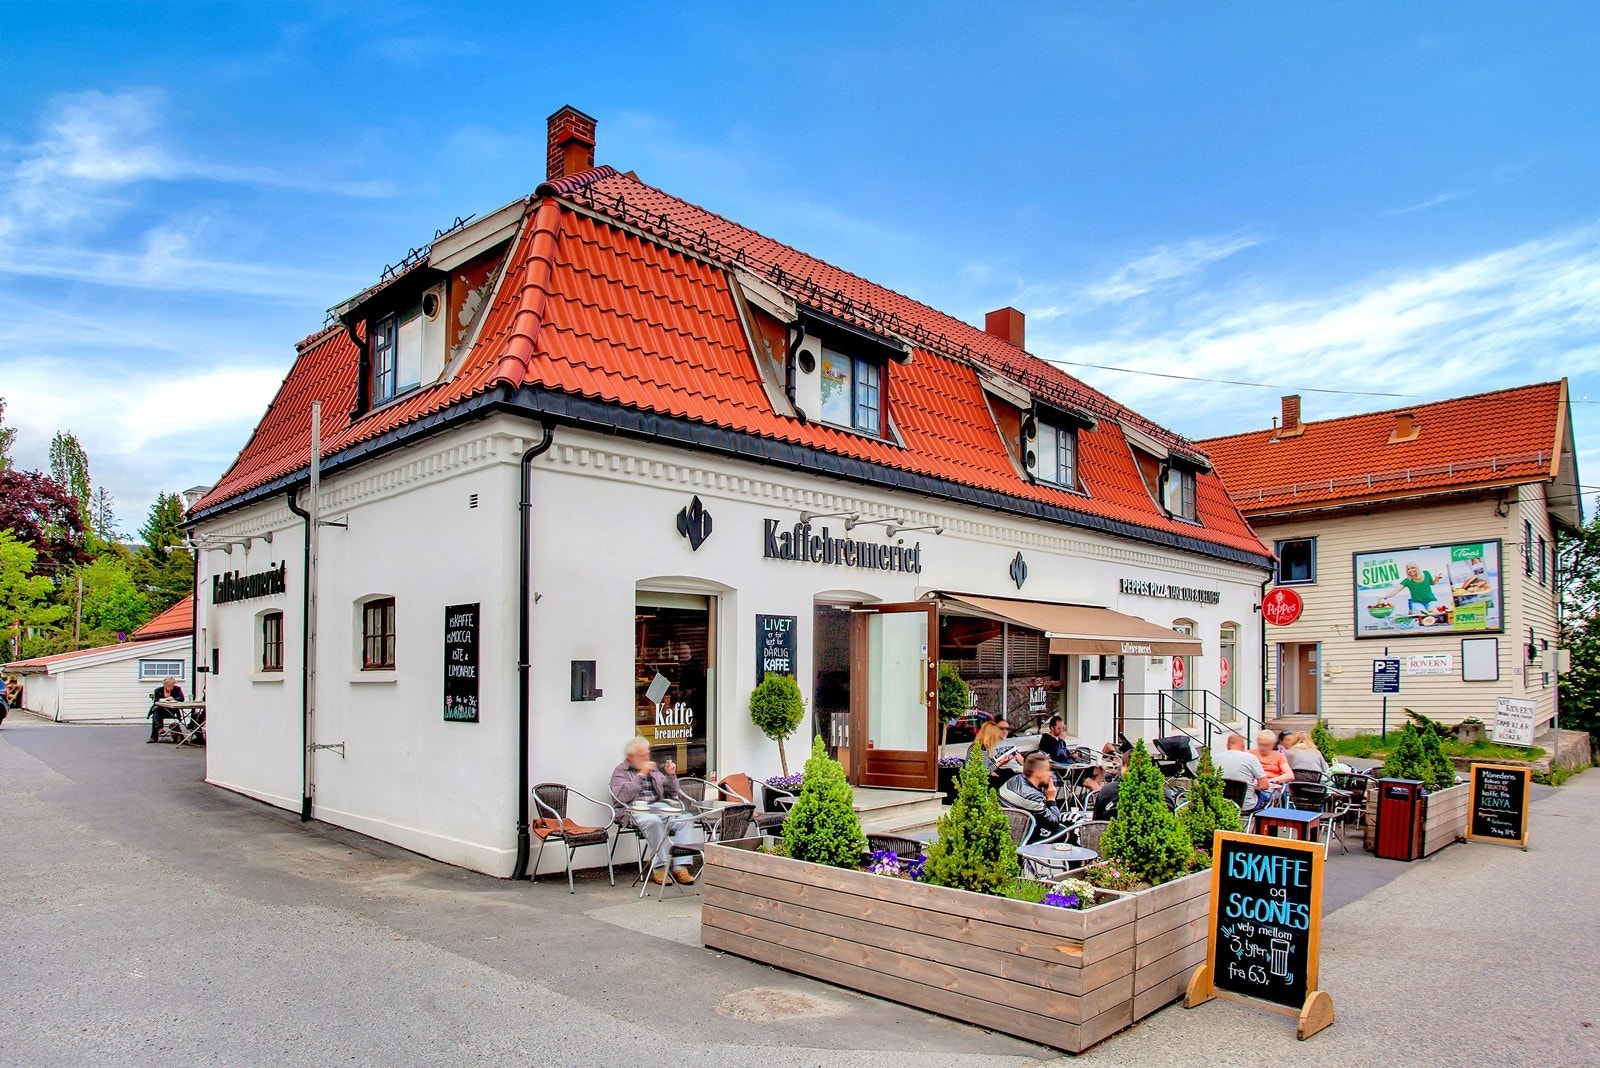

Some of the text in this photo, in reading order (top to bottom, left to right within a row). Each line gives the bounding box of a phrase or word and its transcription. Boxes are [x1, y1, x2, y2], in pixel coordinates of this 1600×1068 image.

[763, 518, 922, 574] Kaffebrenneriet
[1362, 563, 1400, 585] SUNN
[1120, 578, 1149, 596] PEPPES
[1149, 583, 1168, 598] PIZZA
[1266, 602, 1297, 616] Peppes
[764, 618, 792, 632] LIVET
[764, 646, 788, 658] DÅRLIG
[764, 658, 790, 671] KAFFE
[1374, 661, 1386, 673] P
[968, 690, 978, 706] ffe
[1029, 686, 1047, 703] Kaffe
[655, 701, 694, 726] Kaffe
[654, 726, 693, 739] brenneriet
[1481, 797, 1510, 808] KENYA
[1228, 851, 1308, 888] ISKAFFE
[1269, 887, 1287, 906] og
[1225, 892, 1309, 931] SCONES
[1237, 922, 1293, 941] velg mellom
[1230, 935, 1268, 957] 3 typer
[1227, 961, 1247, 980] fra
